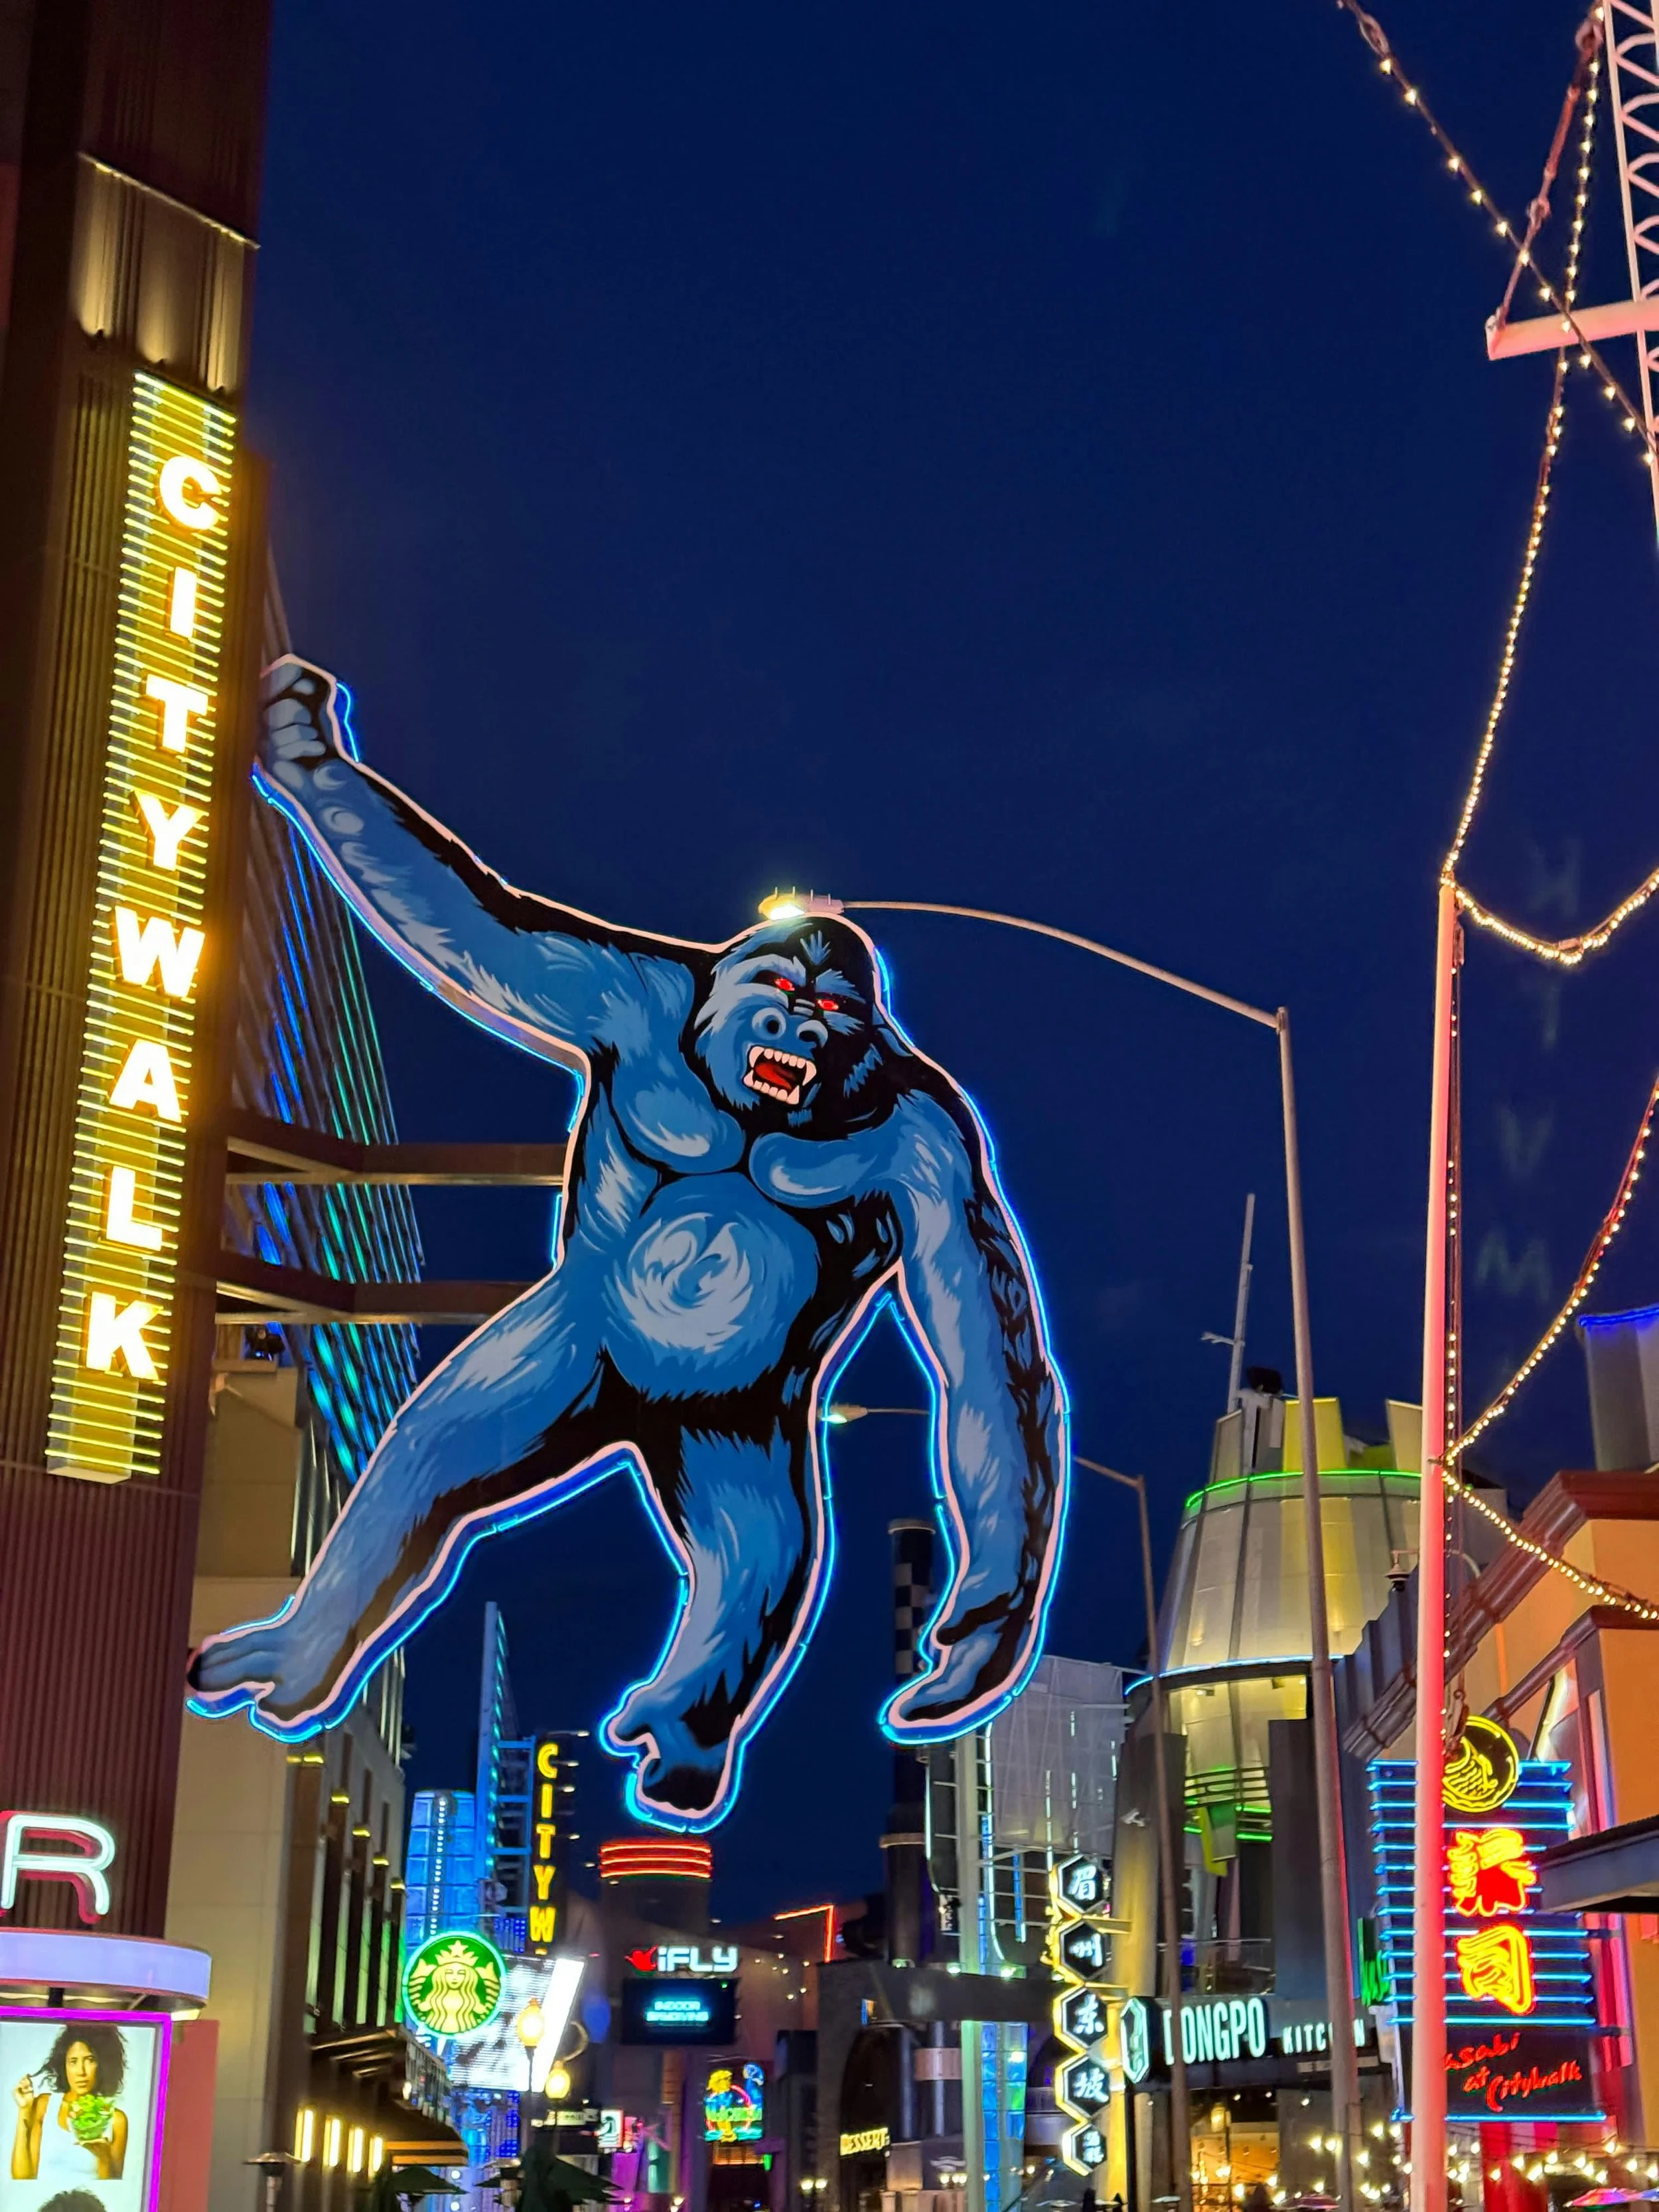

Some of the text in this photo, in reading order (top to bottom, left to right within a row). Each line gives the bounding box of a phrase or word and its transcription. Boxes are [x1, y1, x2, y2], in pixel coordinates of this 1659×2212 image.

[86, 455, 222, 1380] CITYWALK
[530, 1743, 558, 1955] CITYW
[658, 1945, 738, 1972] iFLY
[1283, 2018, 1365, 2054] KITCN
[1444, 2031, 1520, 2071] asabi
[1463, 2065, 1490, 2093] at
